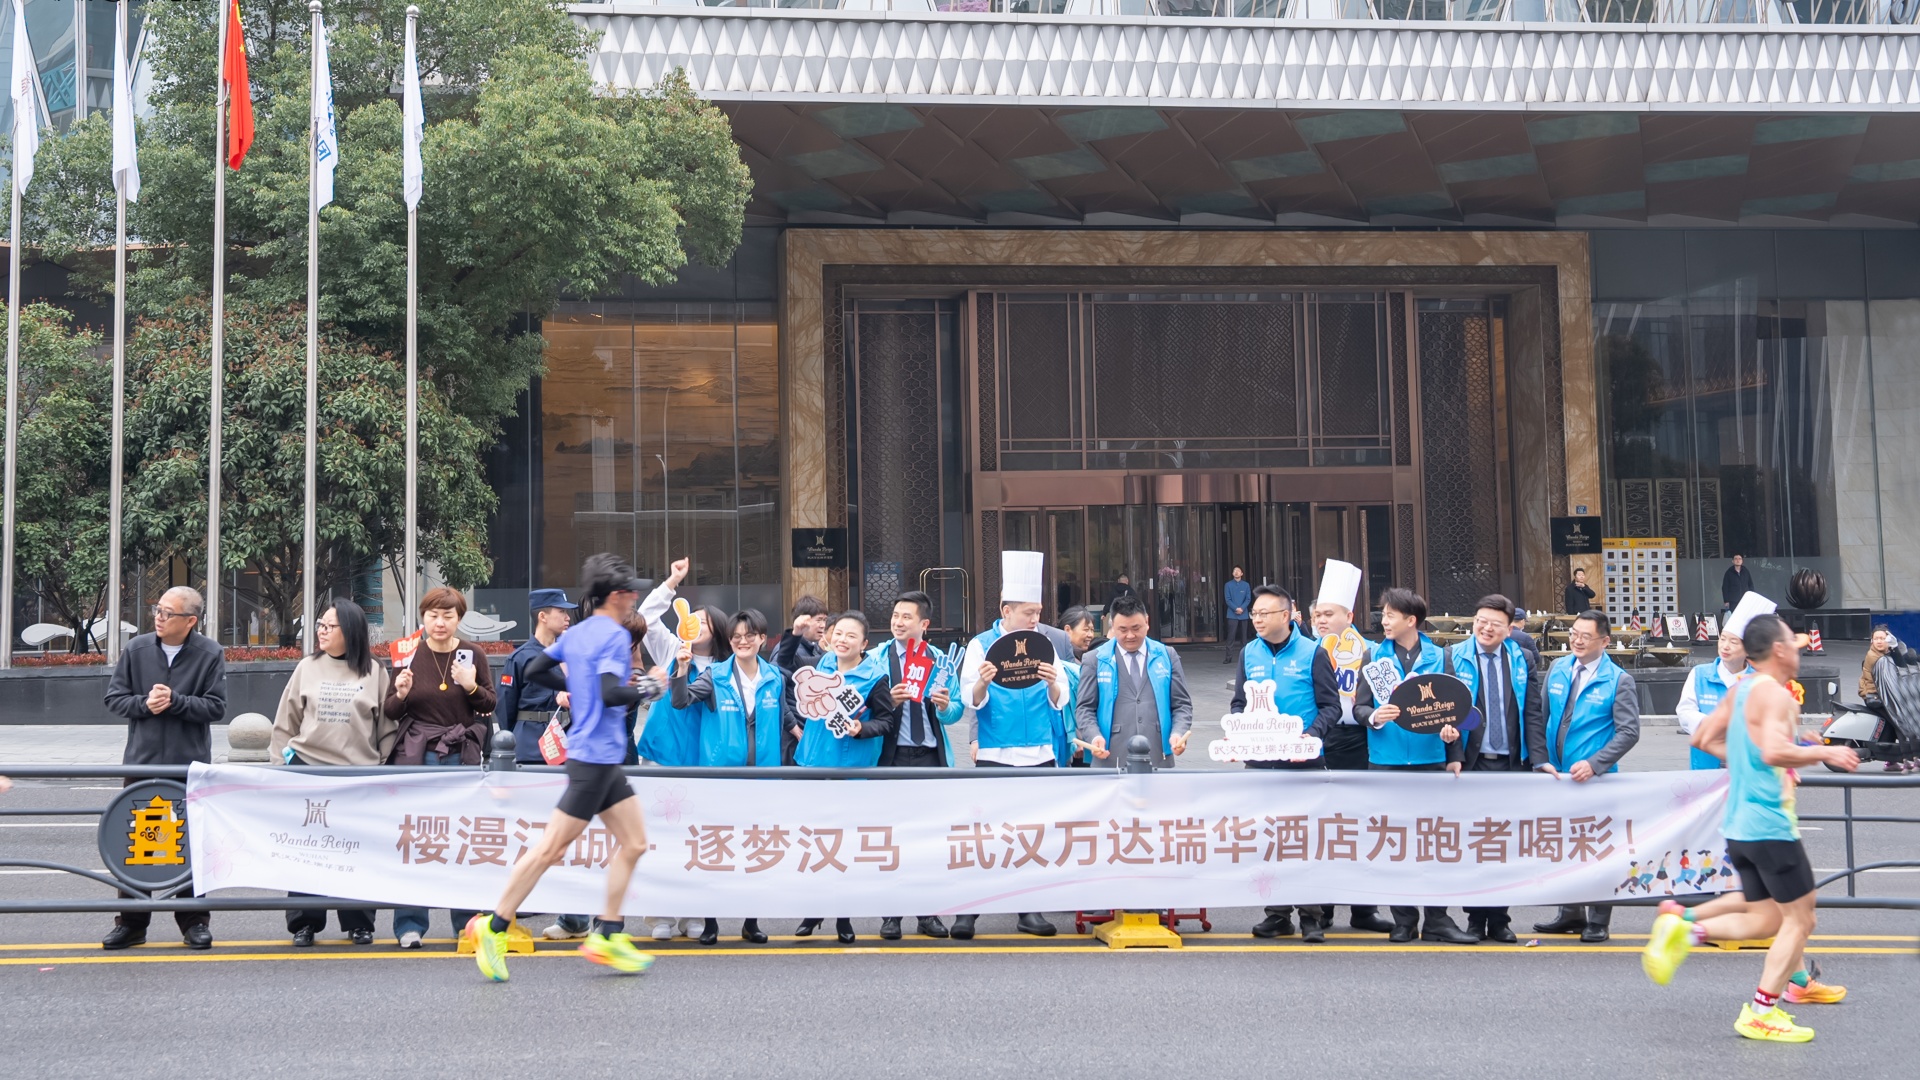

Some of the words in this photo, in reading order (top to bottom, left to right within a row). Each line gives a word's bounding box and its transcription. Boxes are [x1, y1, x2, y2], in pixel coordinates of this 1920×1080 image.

[1406, 703, 1433, 715] Wanda
[1432, 701, 1455, 712] Reign
[1226, 718, 1264, 732] Wanda
[1266, 717, 1298, 734] Reign
[1213, 742, 1317, 756] 武汉万达瑞华酒店
[269, 832, 318, 848] Wanda
[320, 834, 361, 855] Reign
